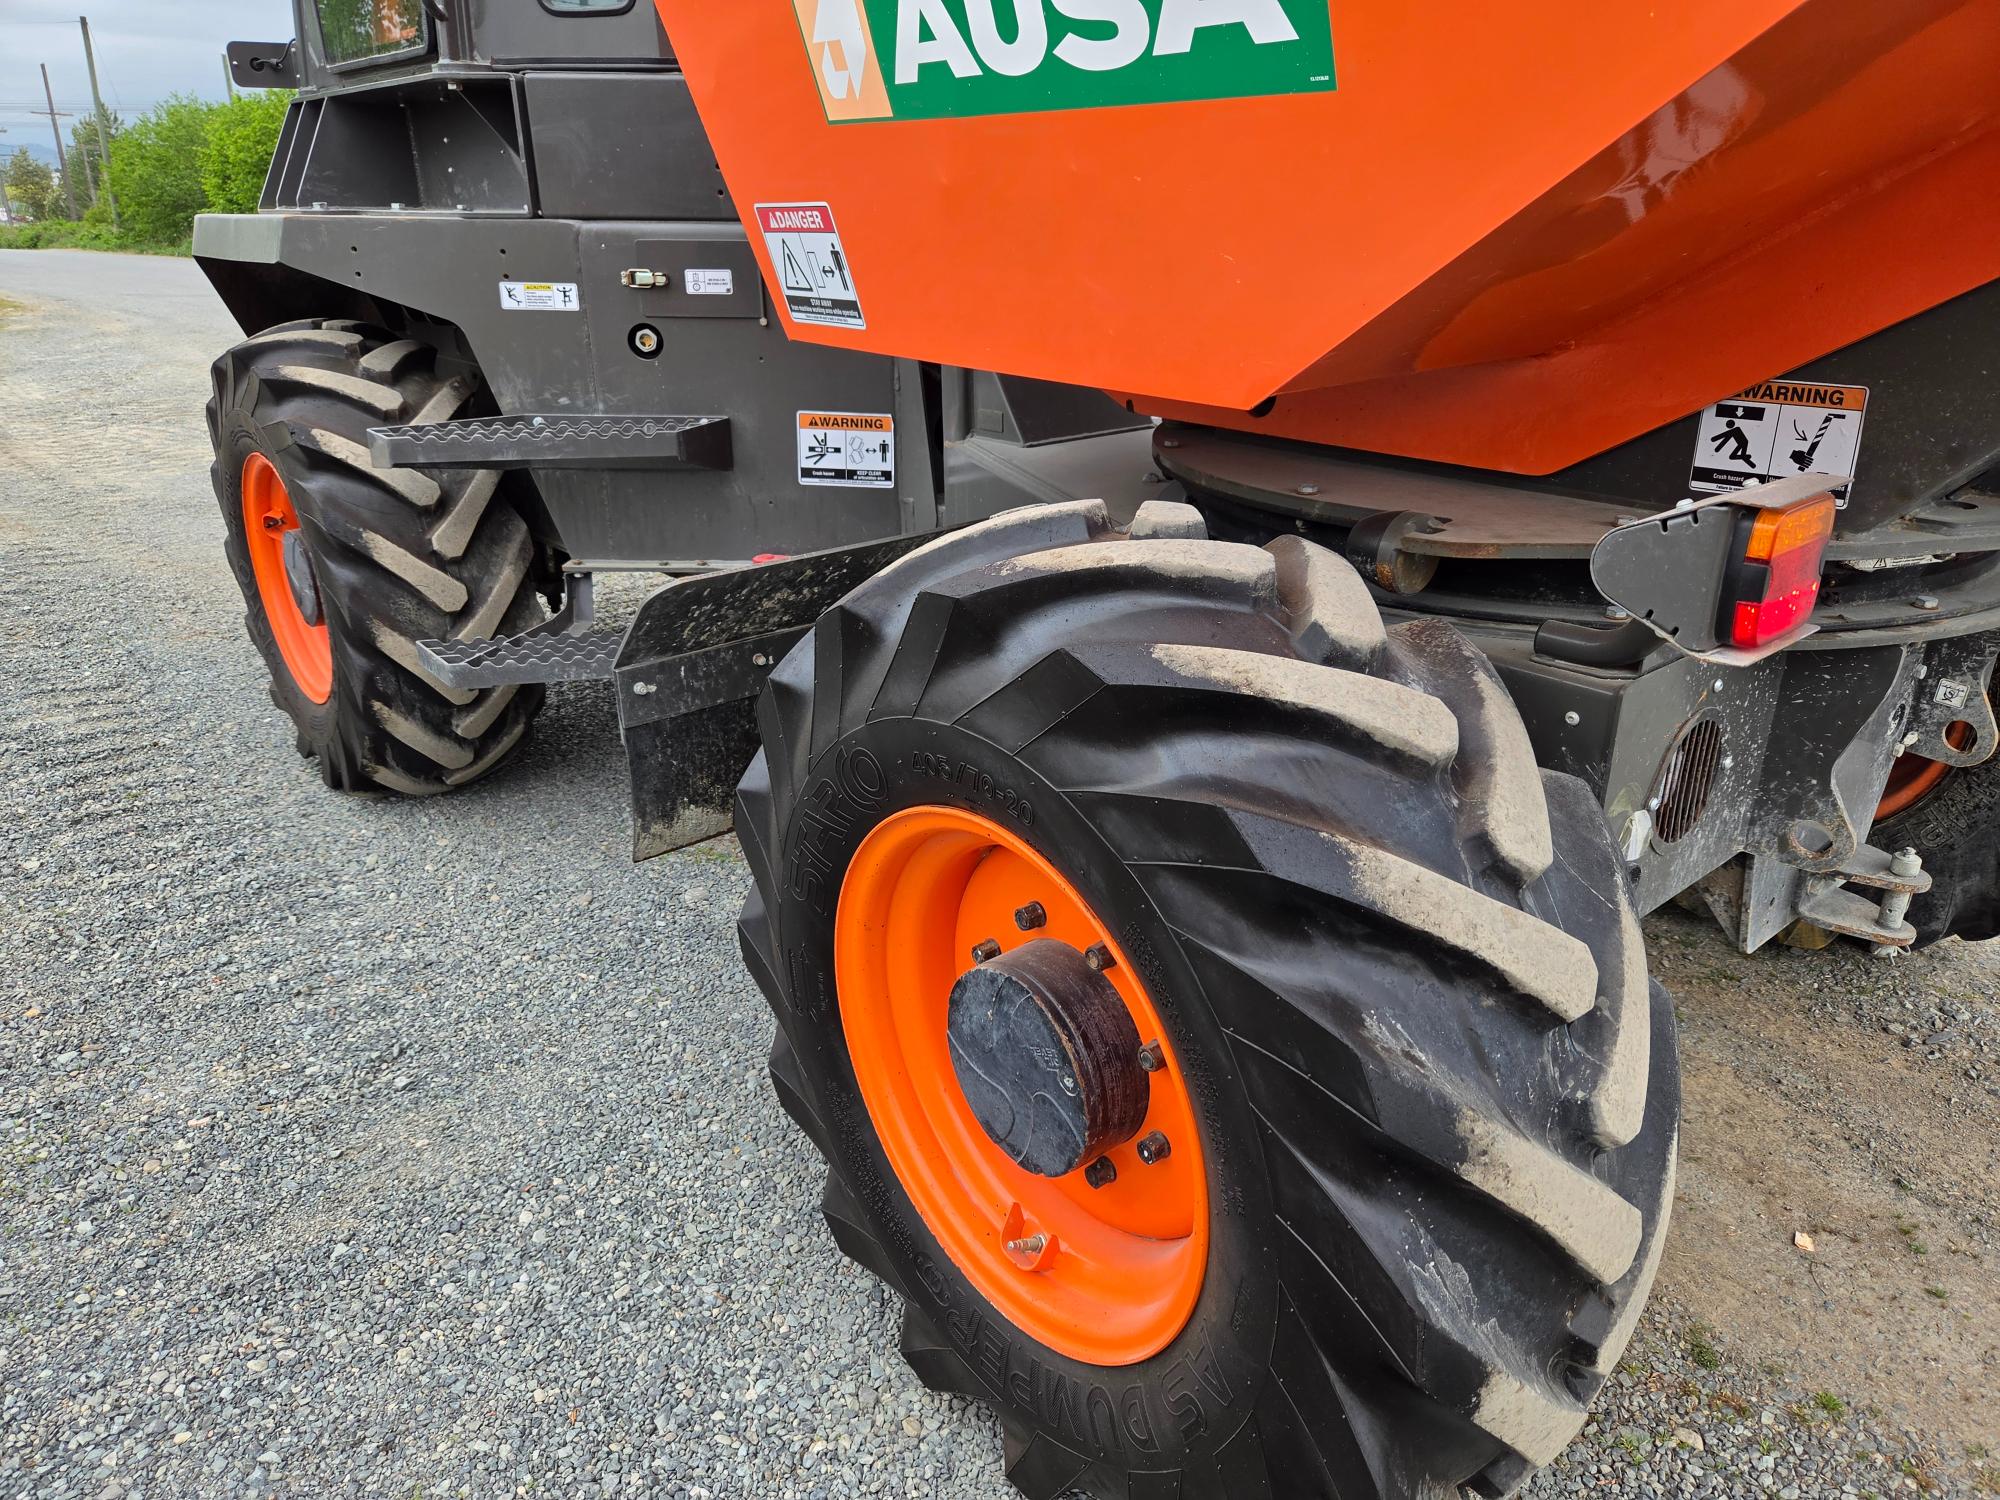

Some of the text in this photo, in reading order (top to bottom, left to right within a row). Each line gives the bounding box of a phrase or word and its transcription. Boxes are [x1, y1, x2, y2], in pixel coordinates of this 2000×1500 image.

[775, 211, 824, 229] DANGER
[1744, 384, 1844, 406] WARNING
[819, 417, 884, 429] WARNING
[945, 1286, 1161, 1453] DUMPER
